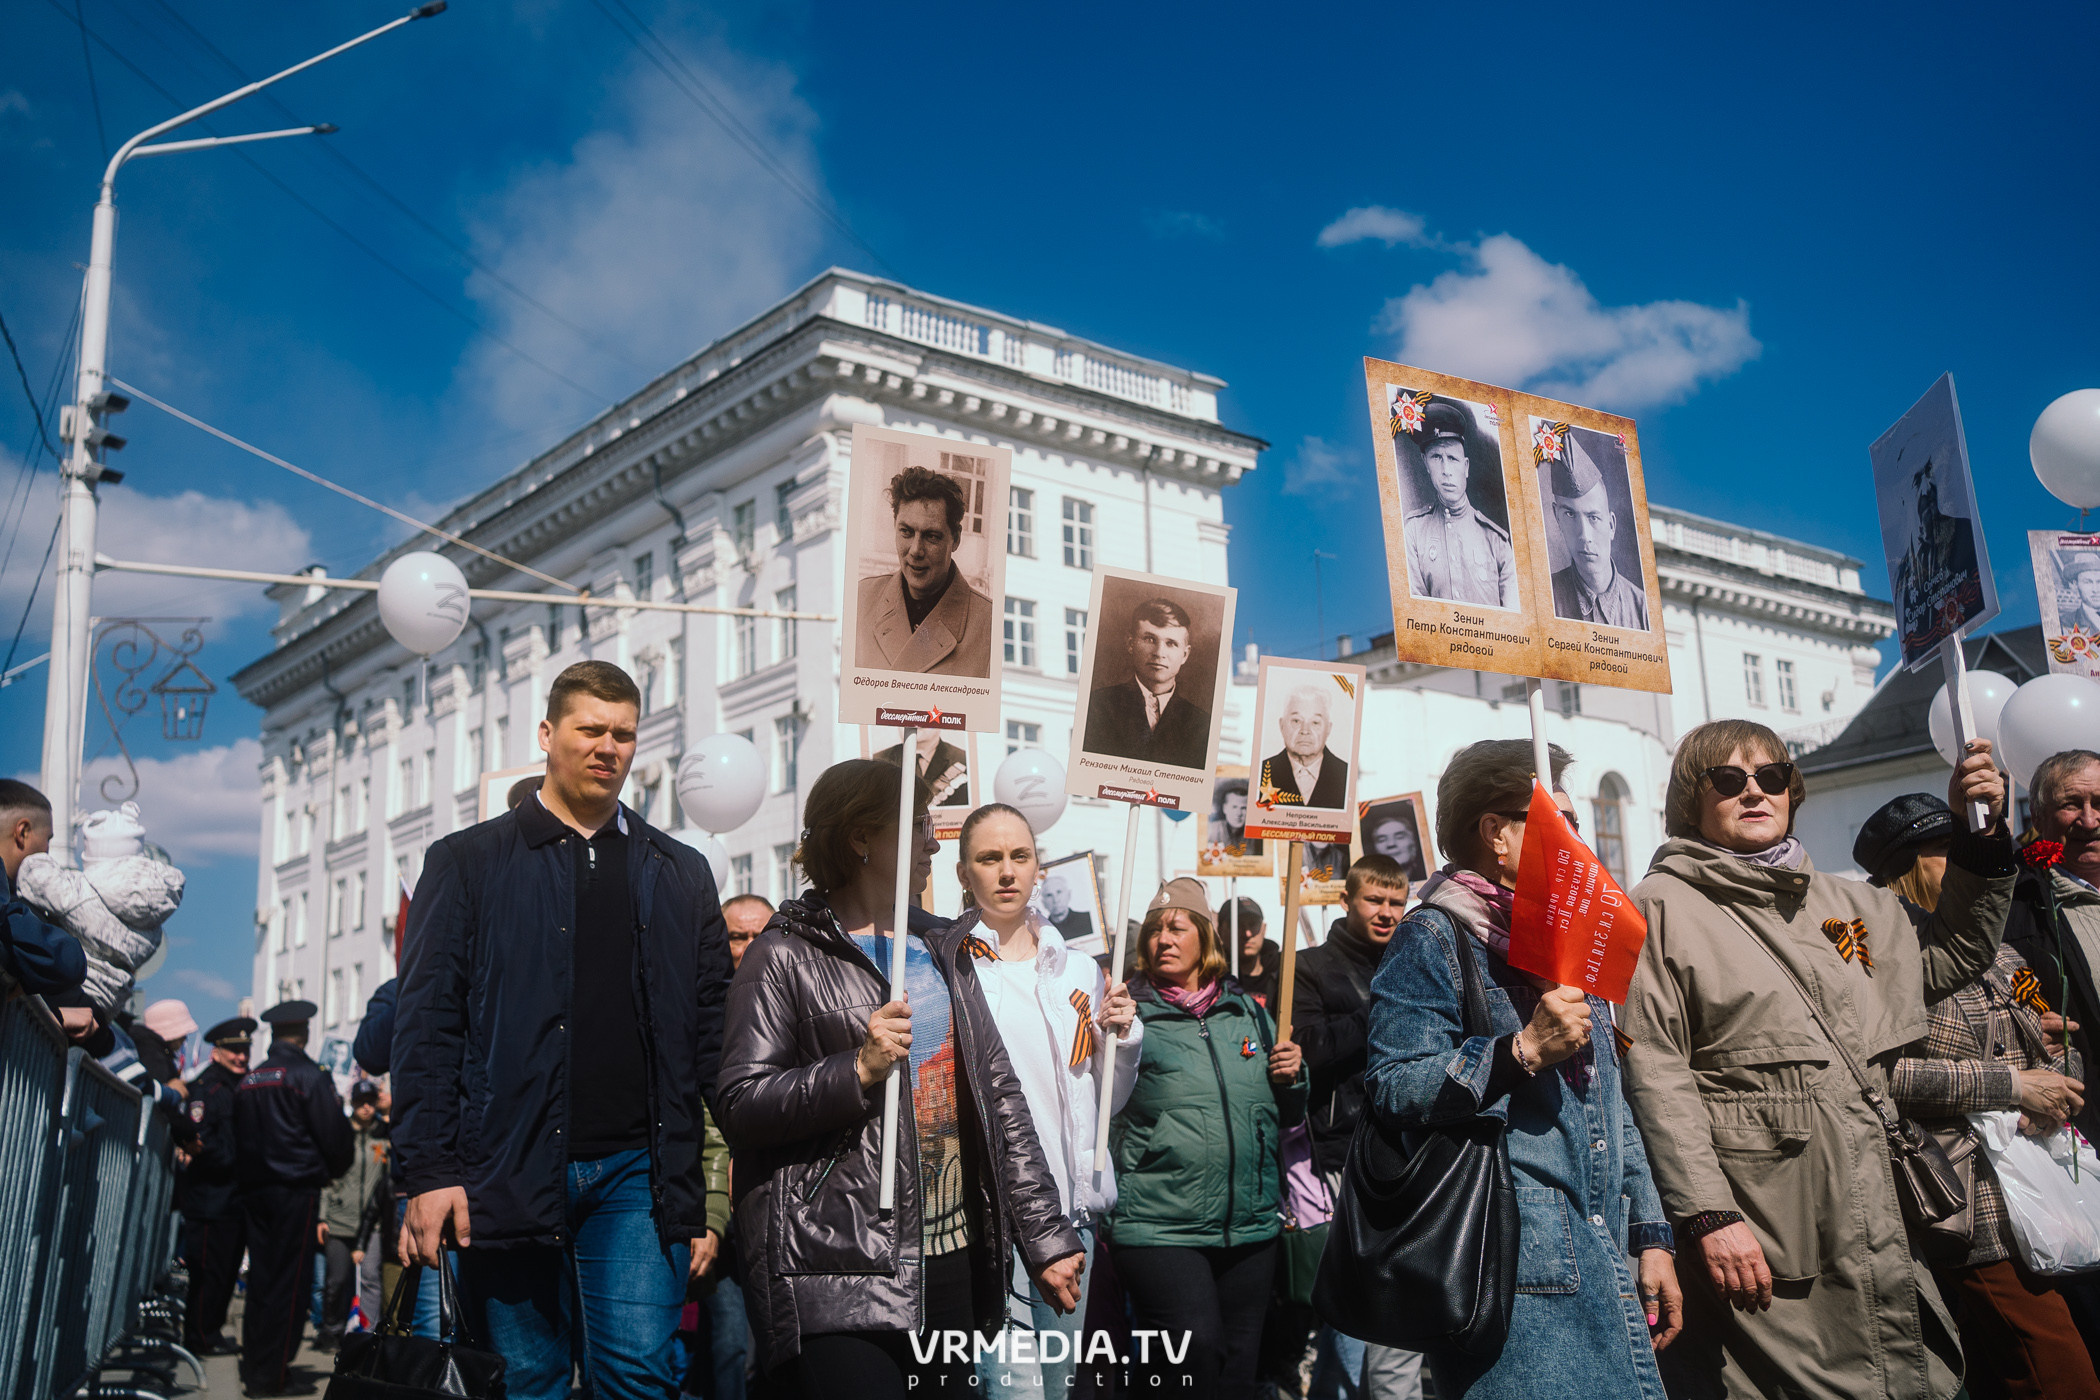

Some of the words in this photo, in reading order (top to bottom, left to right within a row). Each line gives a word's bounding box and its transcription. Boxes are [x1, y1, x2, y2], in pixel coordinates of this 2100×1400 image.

[1926, 569, 1968, 607] Степанович
[1453, 611, 1485, 626] Зенин
[1406, 618, 1437, 635] Петр
[1439, 622, 1531, 646] Константинович
[1592, 631, 1620, 645] Зенин
[1449, 641, 1494, 657] рядовой
[1547, 637, 1582, 653] Сергей
[1584, 642, 1664, 664] Константинович
[1589, 660, 1629, 674] рядовой
[853, 676, 889, 689] Фёдоров
[891, 679, 928, 691] Вячеслав
[929, 682, 990, 696] Александрович
[941, 716, 962, 725] ПОЛК
[1080, 757, 1119, 772] Рензович
[1119, 764, 1152, 776] Михаил
[1154, 769, 1204, 785] Степанович
[1128, 776, 1154, 786] Рядовой
[1157, 796, 1177, 805] ПОЛК
[1261, 818, 1298, 828] Александр
[1299, 820, 1339, 829] Васильевич
[942, 830, 962, 839] ПОЛ
[1261, 829, 1316, 840] БЕССМЕРТНЫЙ
[1316, 833, 1336, 841] ПОЛК
